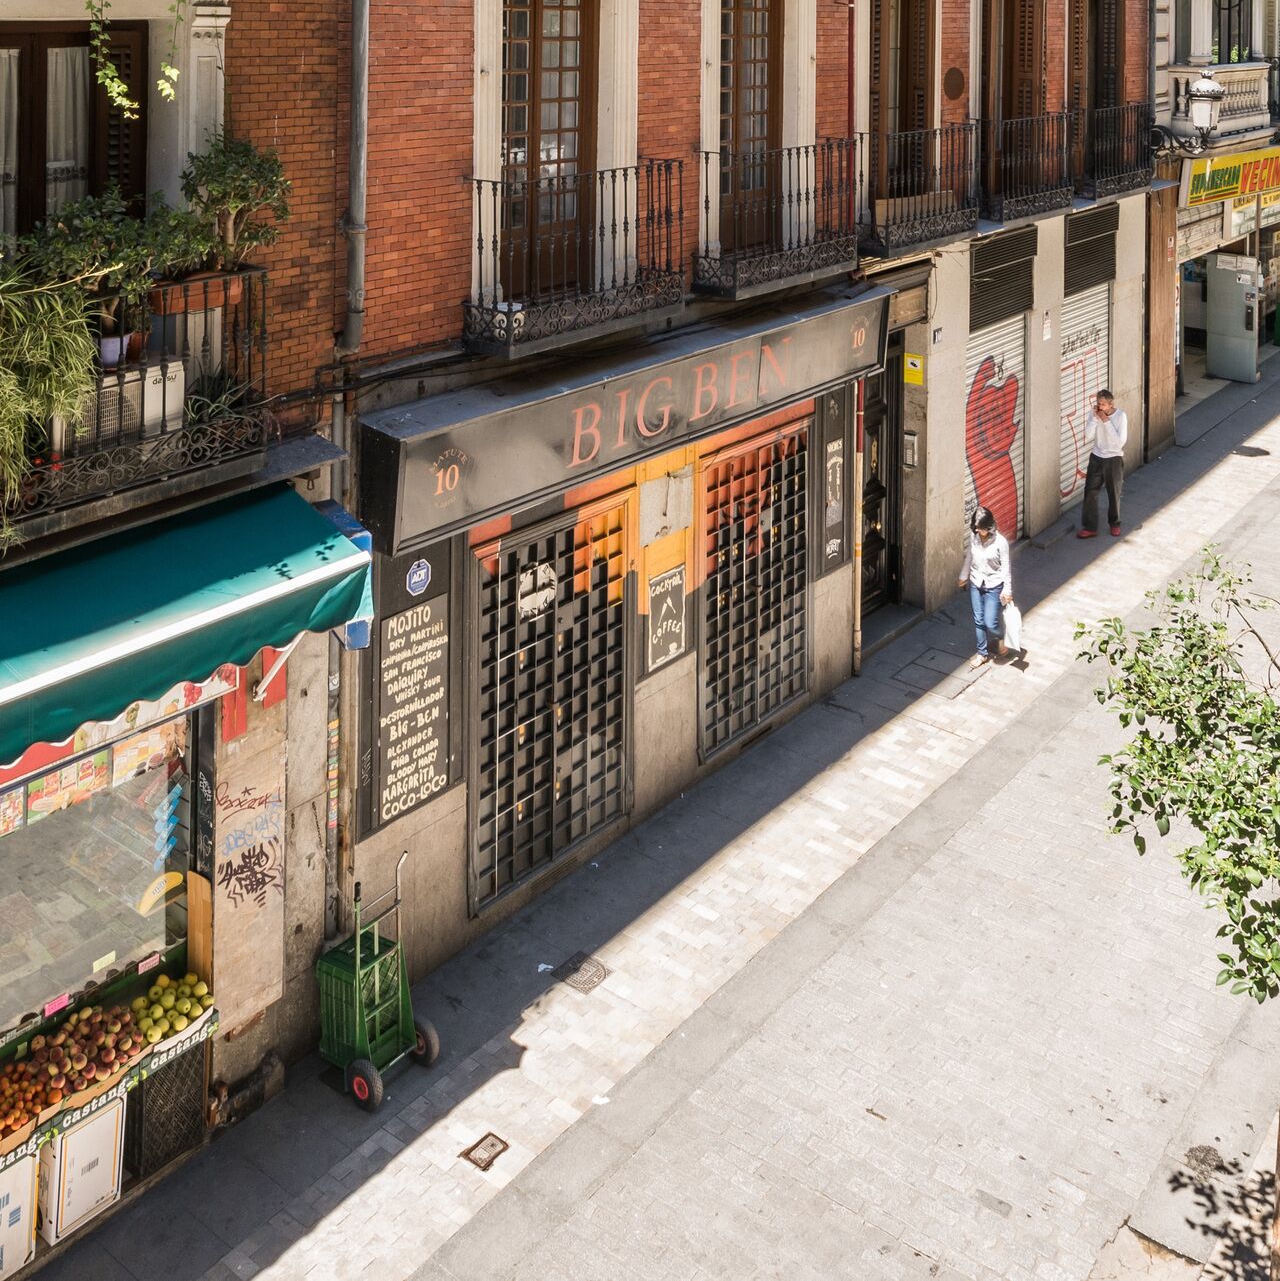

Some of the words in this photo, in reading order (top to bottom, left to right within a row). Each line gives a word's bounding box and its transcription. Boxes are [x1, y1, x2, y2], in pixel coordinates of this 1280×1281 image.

[851, 327, 866, 349] 10
[566, 375, 673, 469] BIG
[687, 336, 793, 423] BEN
[433, 464, 460, 496] 10
[412, 569, 427, 584] ADT
[389, 636, 406, 651] DRY
[652, 619, 682, 644] COFFEE
[383, 667, 399, 682] SAN
[423, 675, 441, 689] SOUR
[387, 727, 433, 759] ALEXANDER
[412, 738, 439, 759] COLADA
[387, 761, 417, 785] BLOODY
[417, 749, 438, 769] MARY
[382, 774, 447, 820] COCO-LOCO
[150, 1023, 212, 1070] castang
[62, 1075, 132, 1129] castang
